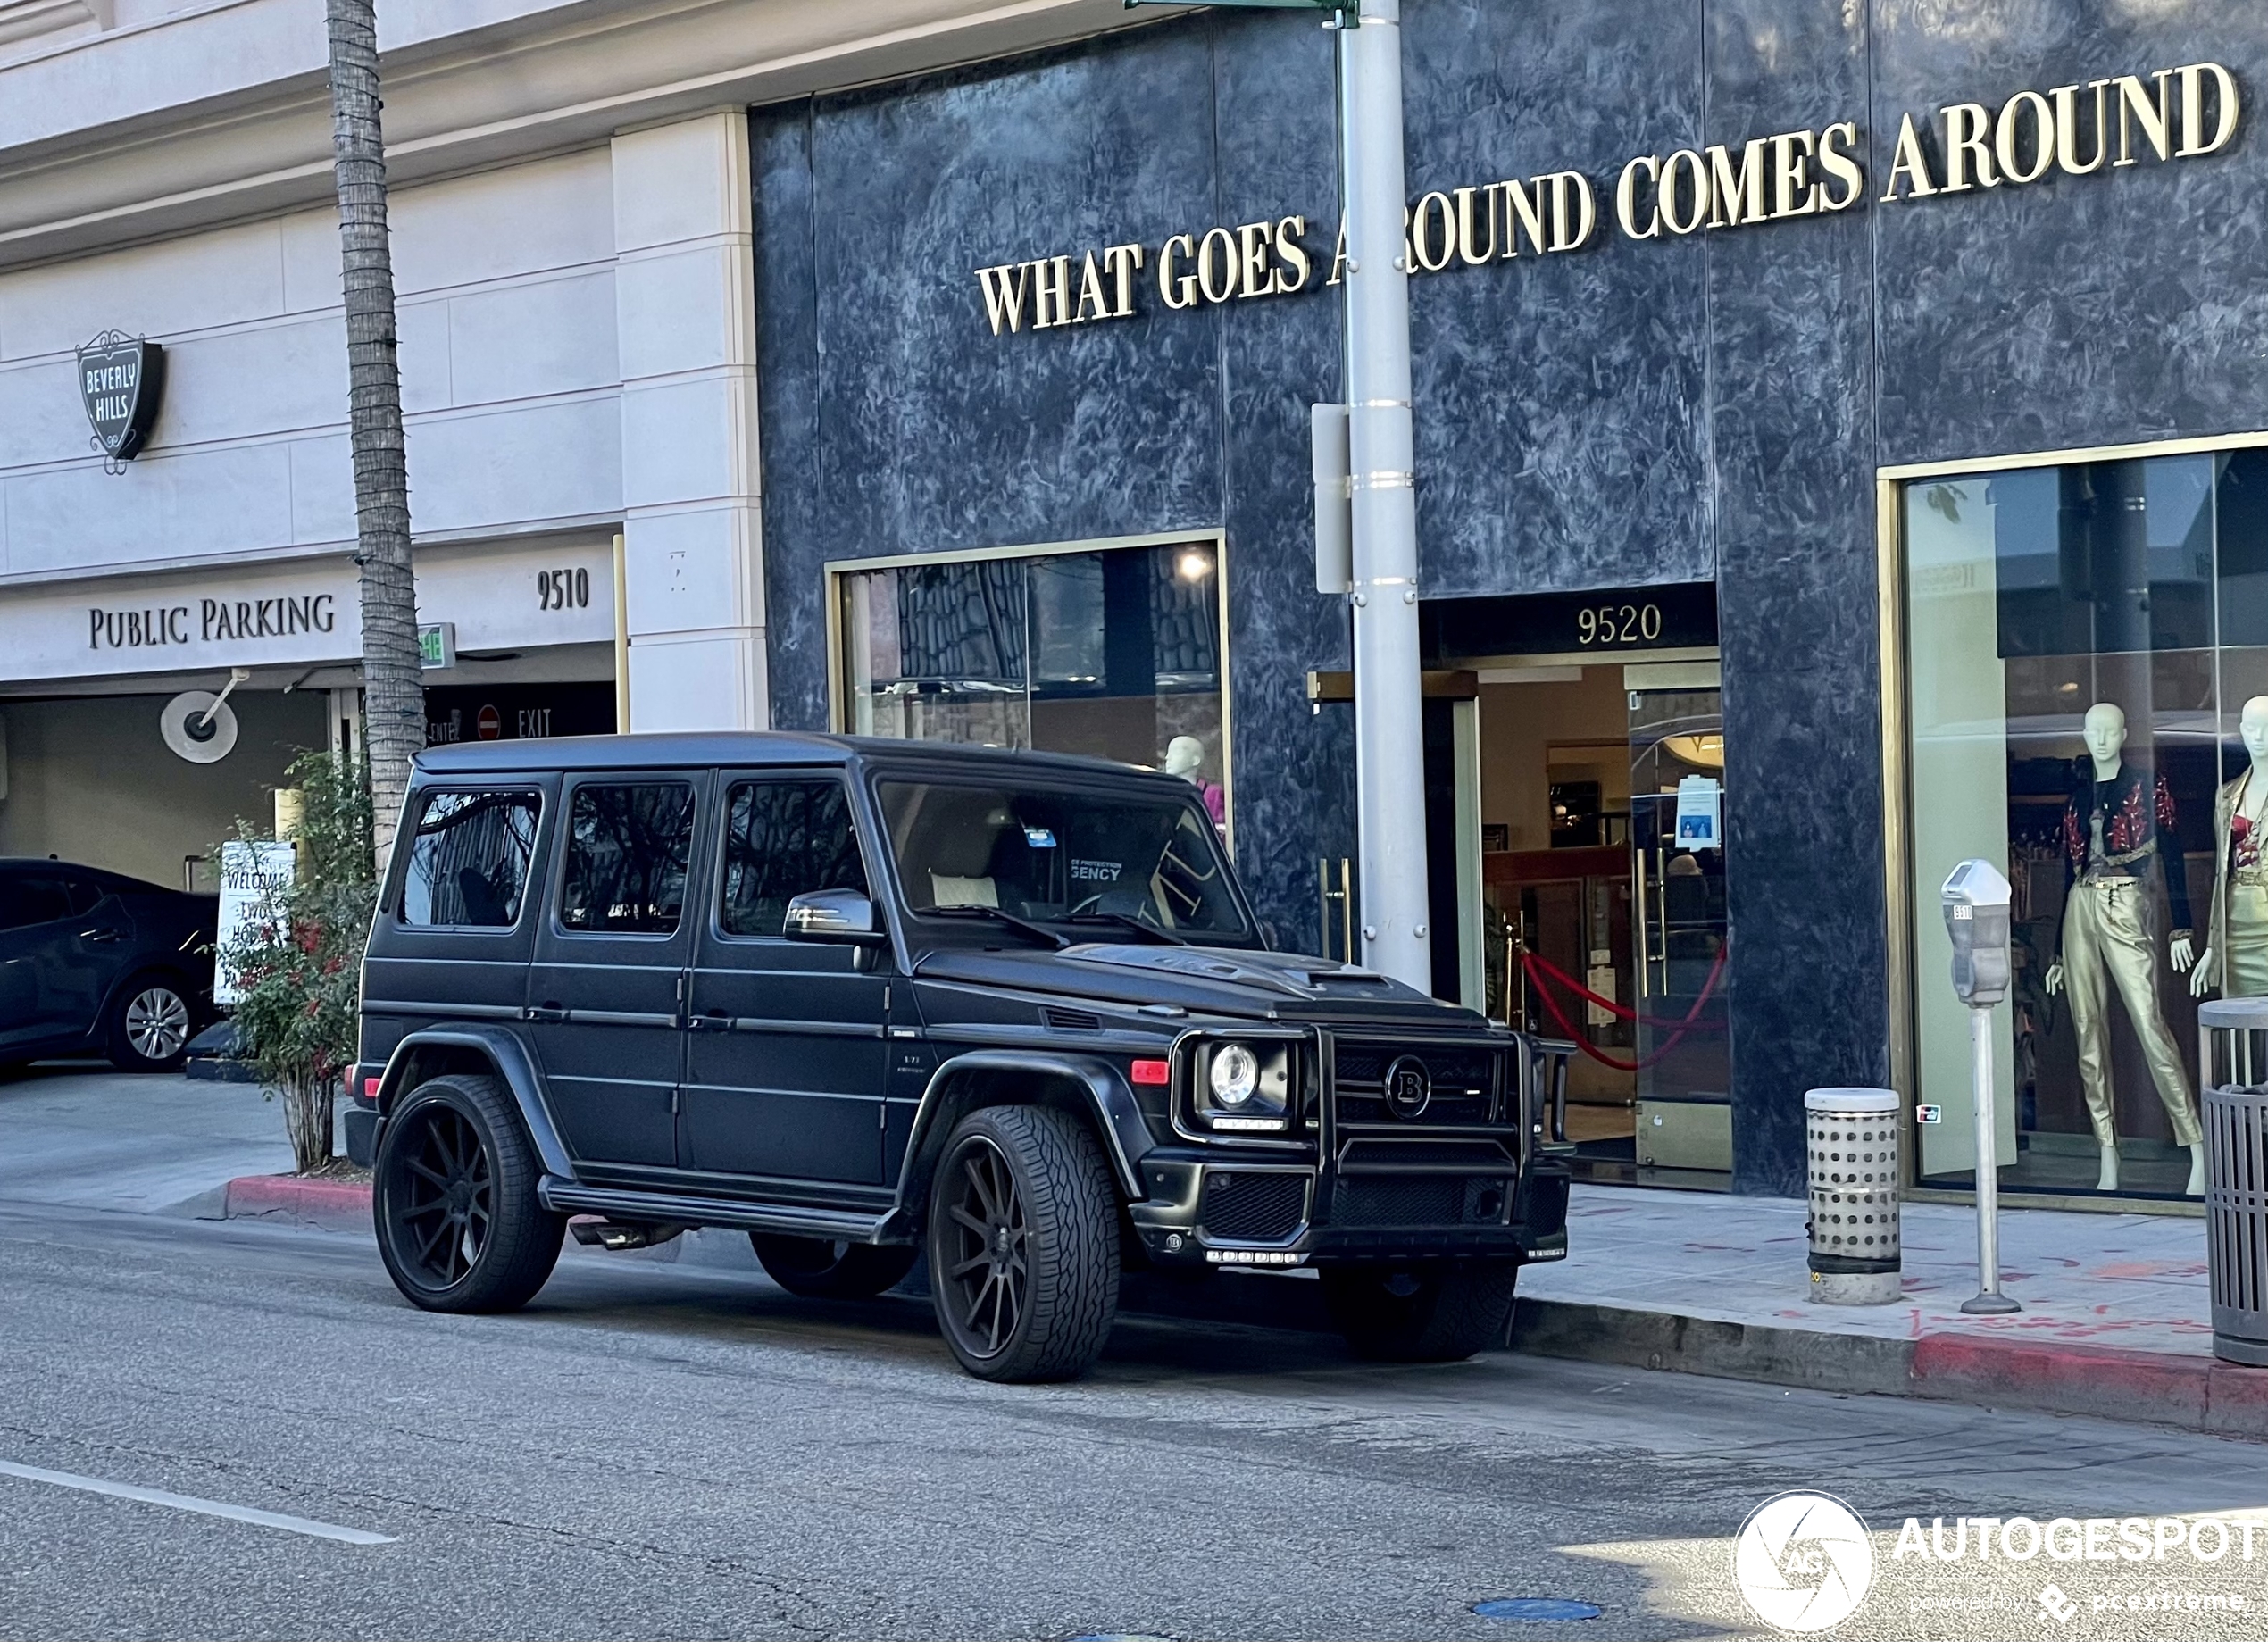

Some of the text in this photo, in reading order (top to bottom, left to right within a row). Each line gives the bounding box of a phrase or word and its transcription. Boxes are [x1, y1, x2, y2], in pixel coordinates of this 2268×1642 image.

[974, 243, 1143, 336] WHAT
[1158, 215, 1311, 310] GOES
[1616, 121, 1863, 240] COMES
[1879, 62, 2239, 203] AROUND
[86, 363, 136, 394] BEVERLY
[96, 394, 128, 421] HILLS
[537, 567, 589, 610] 9510
[88, 594, 335, 649] PUBLIC PARKING
[1578, 604, 1662, 644] 9520
[519, 708, 552, 738] EXIT
[1397, 1071, 1422, 1103] B
